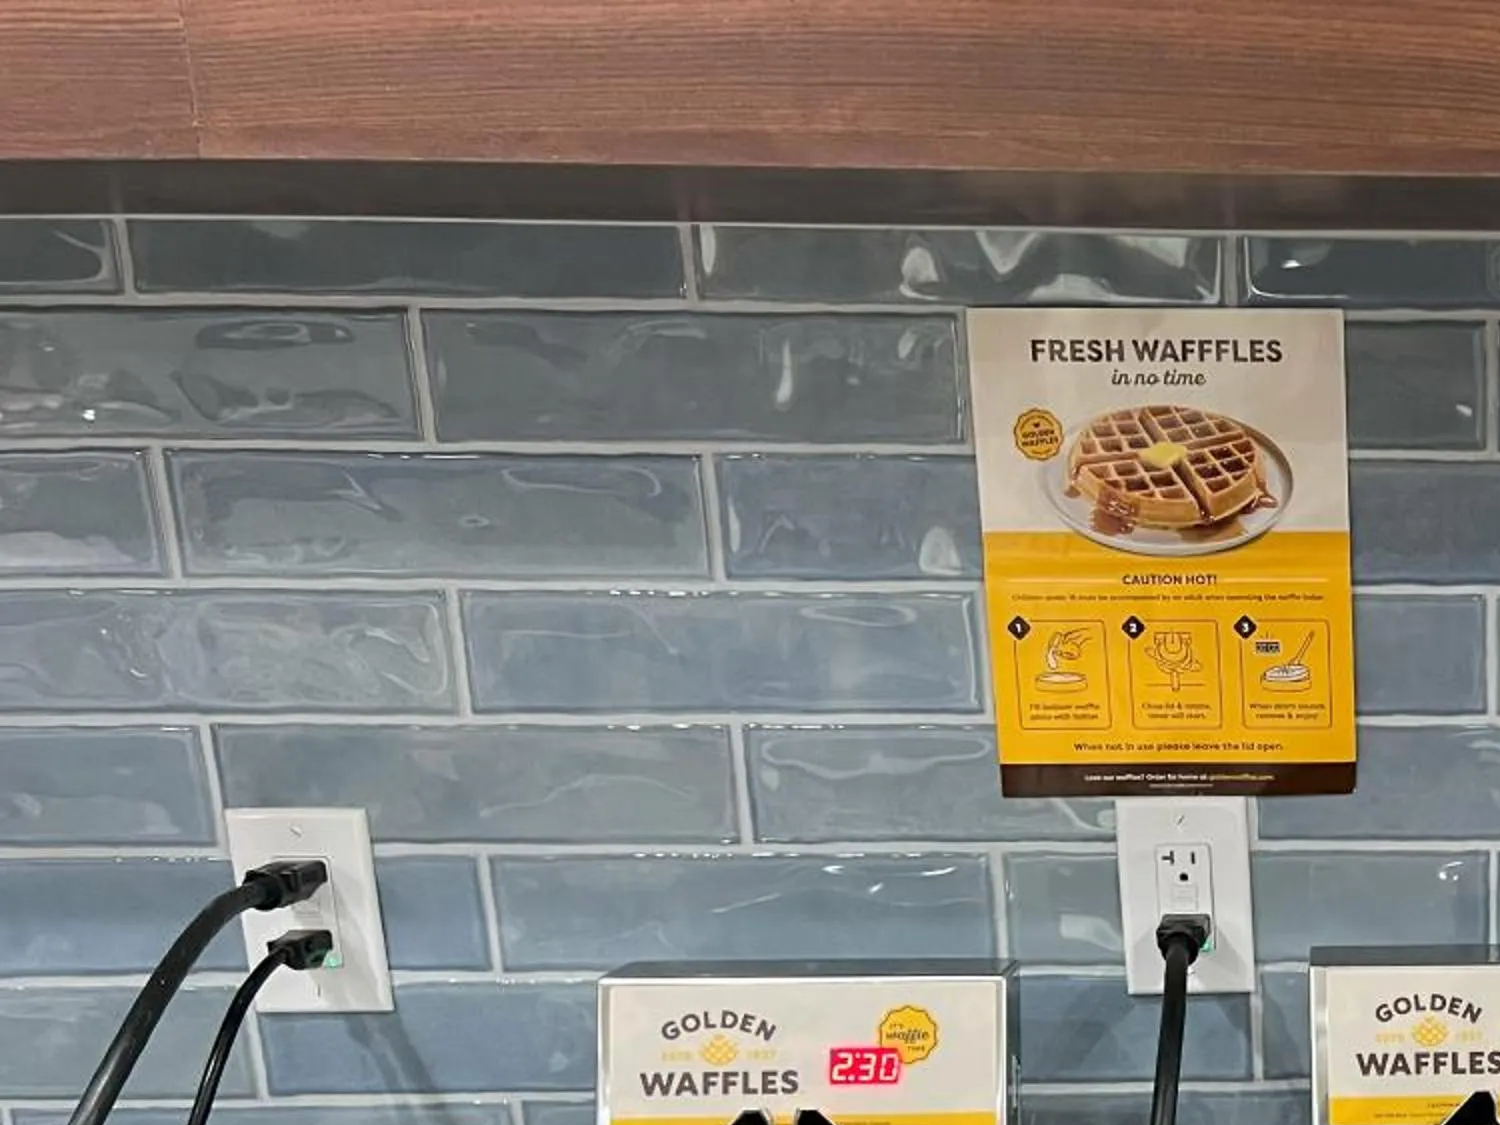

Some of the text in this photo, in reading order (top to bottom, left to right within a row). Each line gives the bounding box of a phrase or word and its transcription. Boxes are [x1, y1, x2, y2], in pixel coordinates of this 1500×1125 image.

[1030, 339, 1125, 363] FRESH
[1111, 369, 1207, 386] in no time
[1122, 574, 1218, 585] CAUTION HOT!
[1015, 623, 1021, 633] 1
[1129, 622, 1137, 633] 2
[1242, 622, 1249, 633] 3
[1074, 742, 1103, 752] When
[1127, 742, 1135, 751] in
[1137, 743, 1155, 751] use
[1156, 743, 1190, 754] please
[1192, 742, 1219, 751] leave
[1222, 742, 1239, 751] the
[1375, 993, 1483, 1024] GOLDEN
[661, 1009, 777, 1041] GOLDEN
[639, 1070, 799, 1097] WAFFLES
